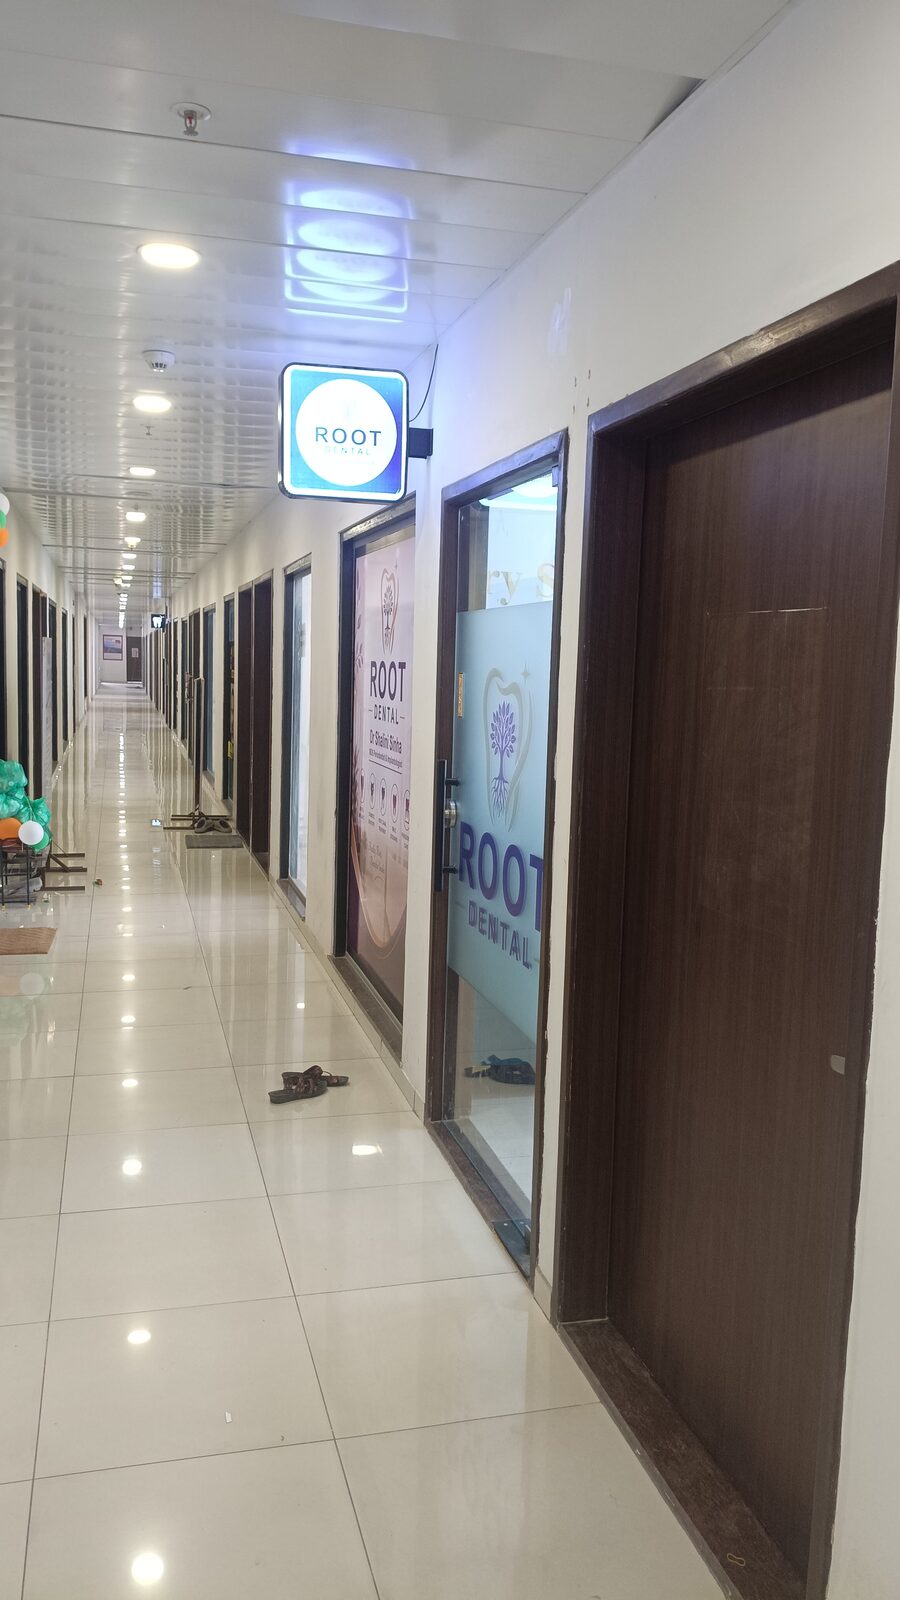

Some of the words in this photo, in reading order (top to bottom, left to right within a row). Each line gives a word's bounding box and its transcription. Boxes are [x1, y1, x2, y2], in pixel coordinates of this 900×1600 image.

[315, 427, 382, 447] ROOT
[325, 446, 371, 456] DENTAL
[370, 661, 406, 702] ROOT
[373, 704, 399, 725] DENTAL
[458, 821, 544, 931] ROOT
[468, 900, 532, 969] DENTAL
